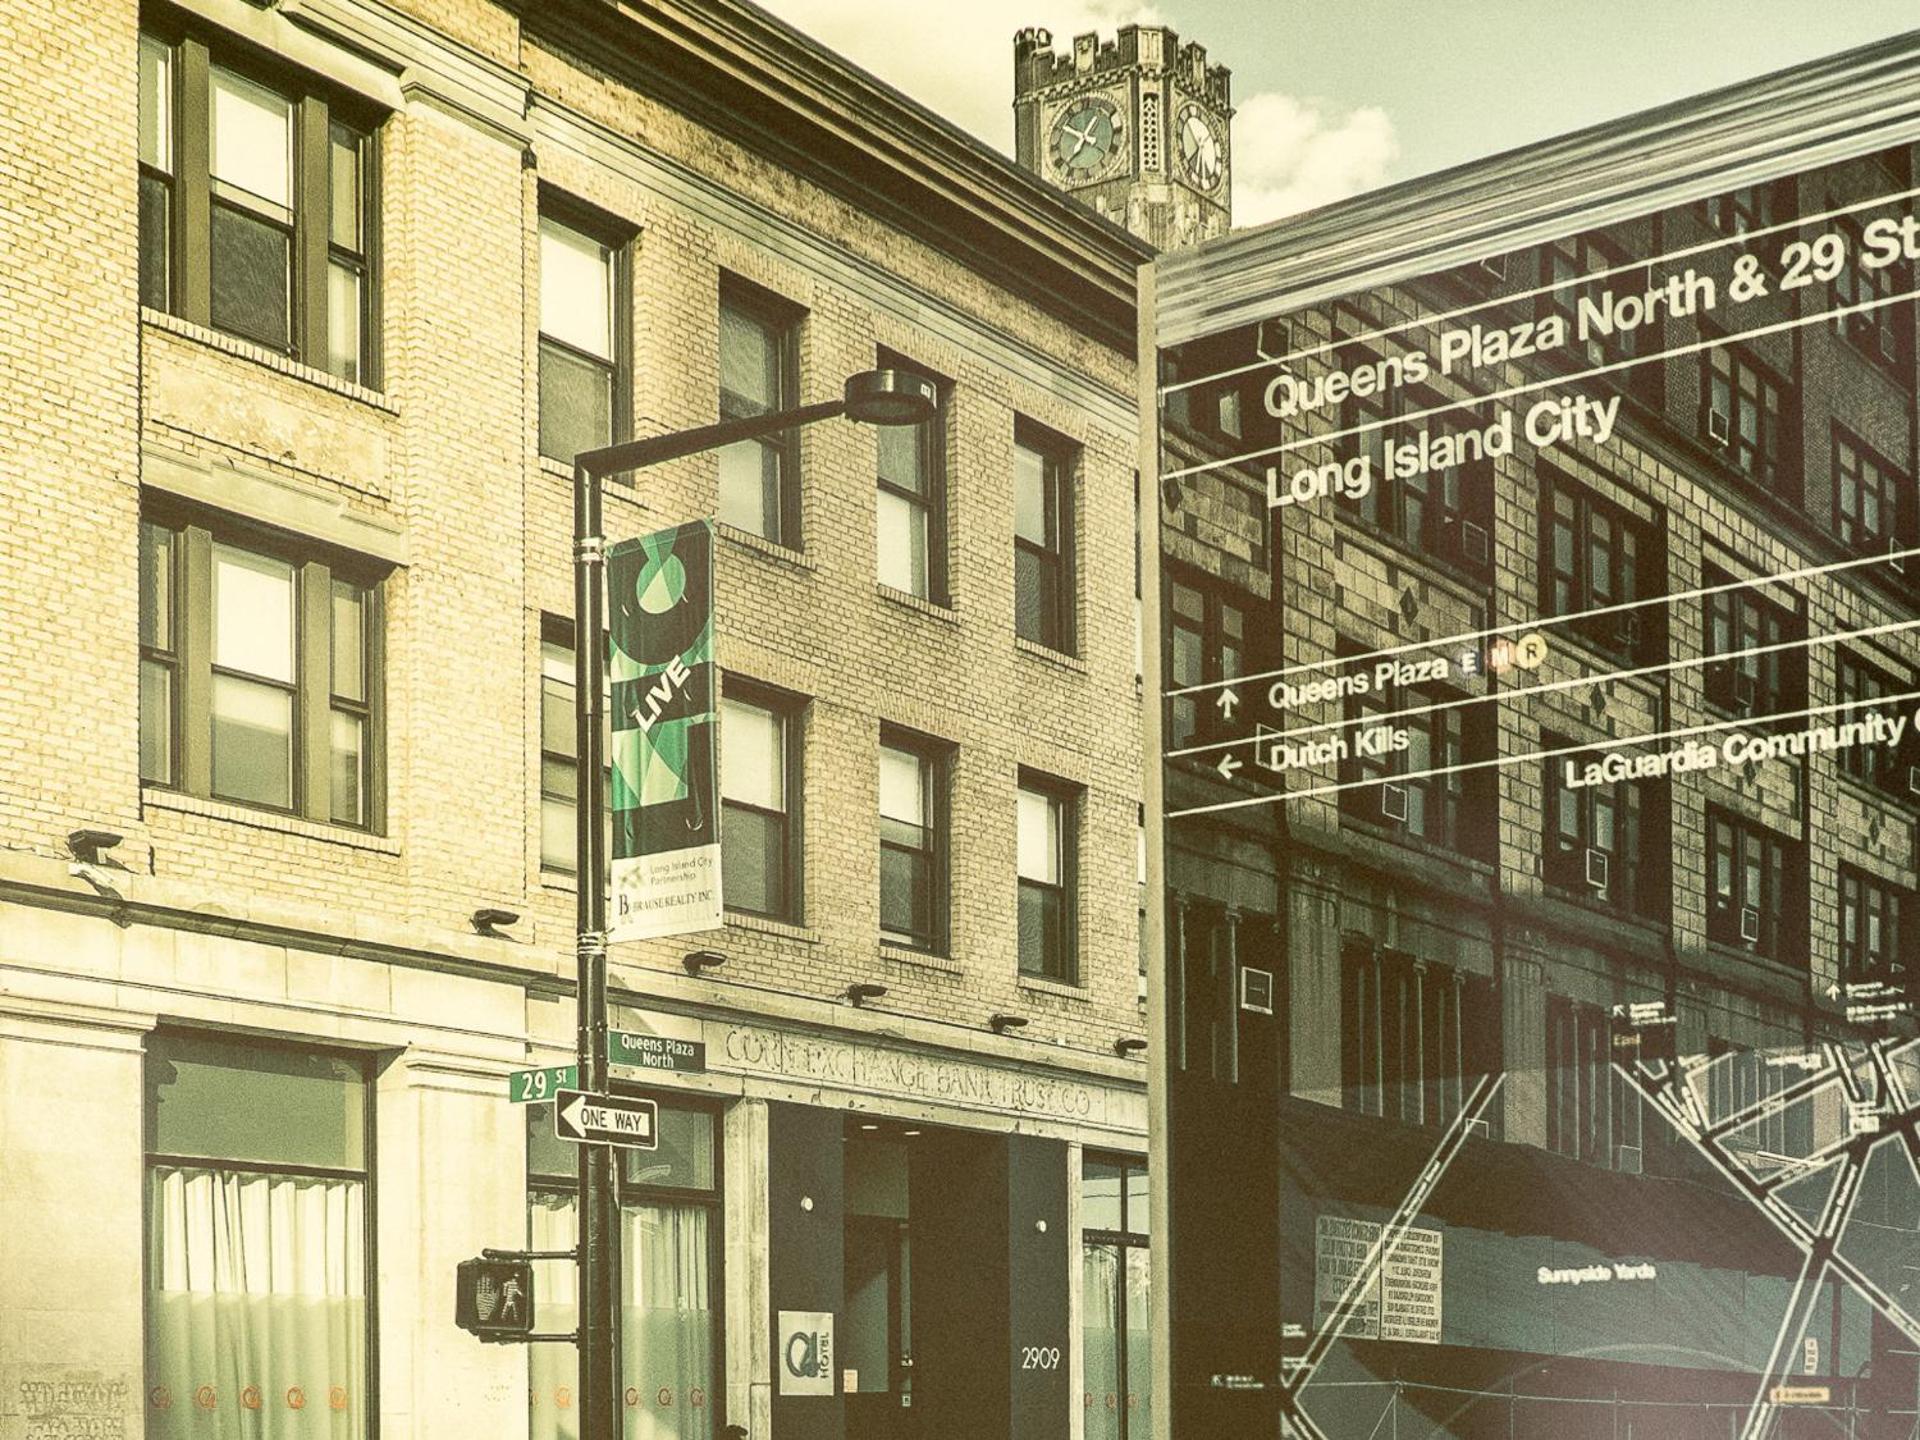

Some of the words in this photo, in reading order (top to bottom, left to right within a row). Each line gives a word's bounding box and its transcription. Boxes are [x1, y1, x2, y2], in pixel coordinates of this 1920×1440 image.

[1264, 351, 1428, 418] Queens
[1441, 315, 1564, 375] Plaza
[1579, 269, 1715, 341] North
[1729, 254, 1768, 302] &
[1779, 233, 1845, 291] 29
[1861, 215, 1920, 269] St
[1267, 455, 1370, 508] Long
[1384, 410, 1513, 481] Island
[1525, 395, 1621, 448] City
[634, 654, 691, 733] LIVE
[1269, 671, 1369, 709] Queens
[1375, 657, 1449, 691] Plaza
[1462, 652, 1477, 673] E
[1271, 734, 1348, 772] Dutch
[1355, 725, 1410, 757] Kills
[1566, 740, 1717, 789] LaGuardia
[1723, 712, 1906, 766] Community
[621, 1033, 663, 1053] Queens
[666, 1039, 695, 1057] Plaza
[642, 1052, 675, 1069] North
[521, 1071, 547, 1100] 29
[556, 1069, 567, 1084] St
[580, 1107, 607, 1129] ONE
[614, 1112, 643, 1132] WAY
[819, 1332, 830, 1379] HOTEL
[1021, 1346, 1061, 1370] 2909
